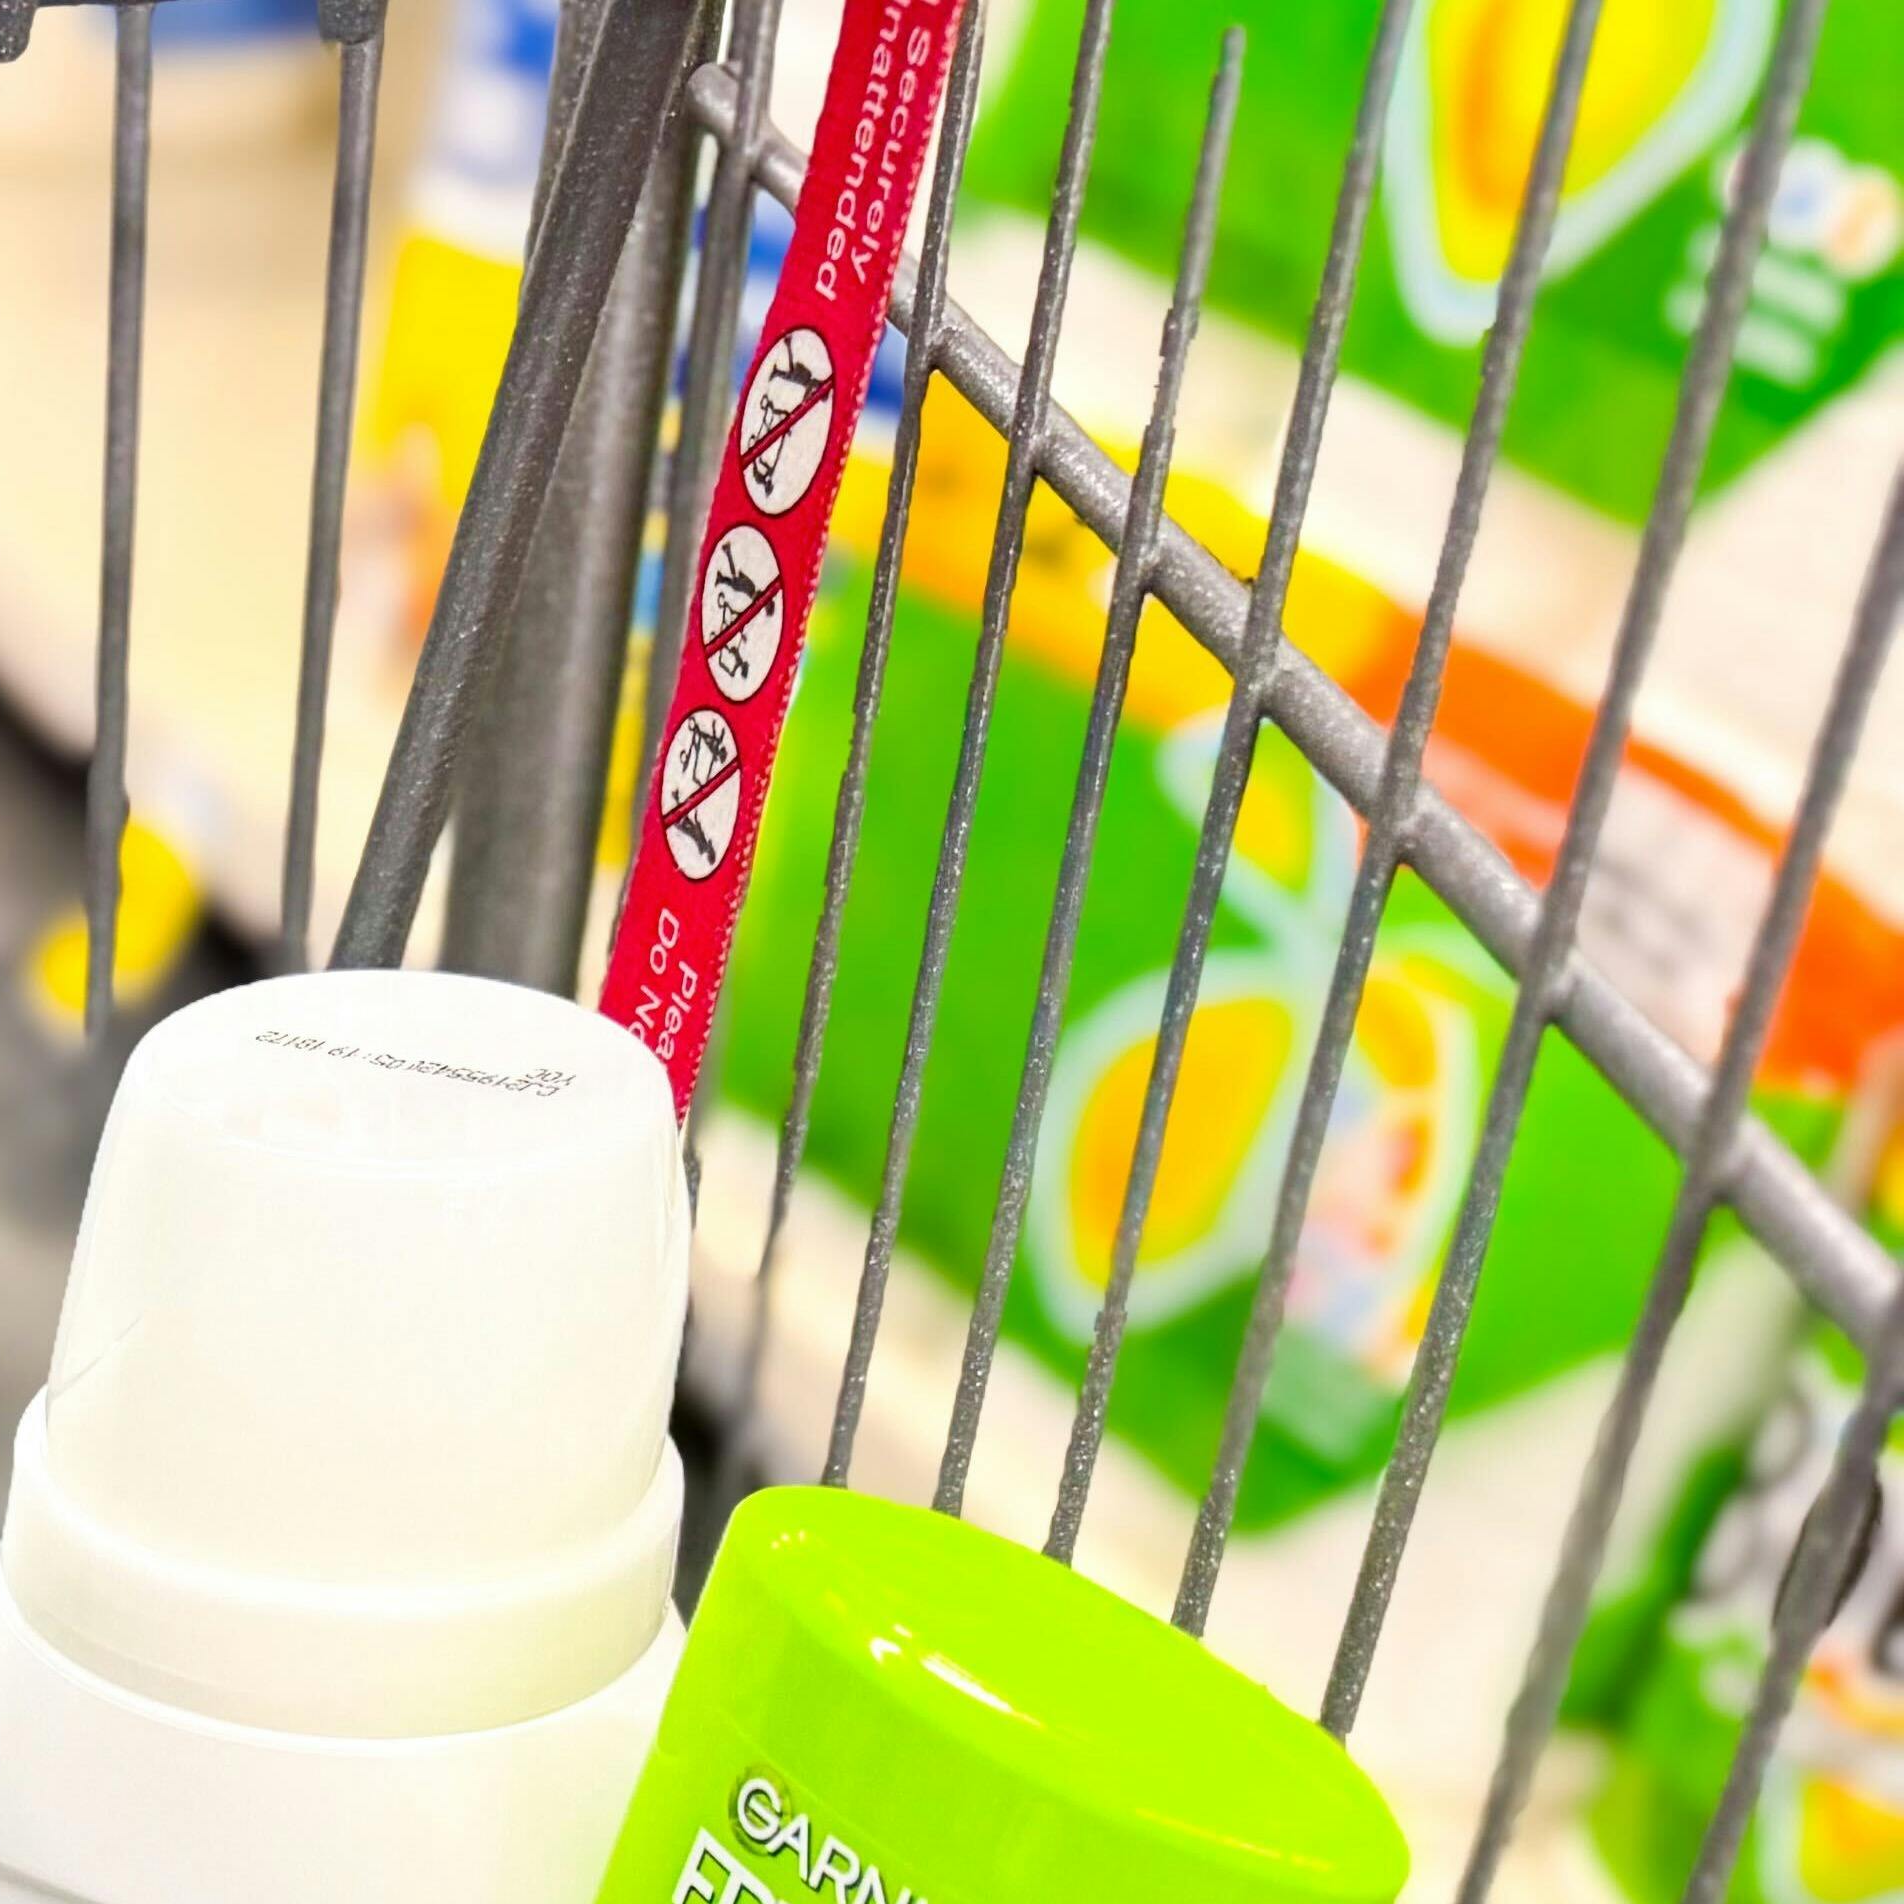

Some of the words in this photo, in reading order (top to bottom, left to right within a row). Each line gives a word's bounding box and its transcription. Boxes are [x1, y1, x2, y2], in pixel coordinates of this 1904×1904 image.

[814, 0, 911, 302] nattended
[851, 26, 931, 284] Securely
[650, 908, 679, 974] Do
